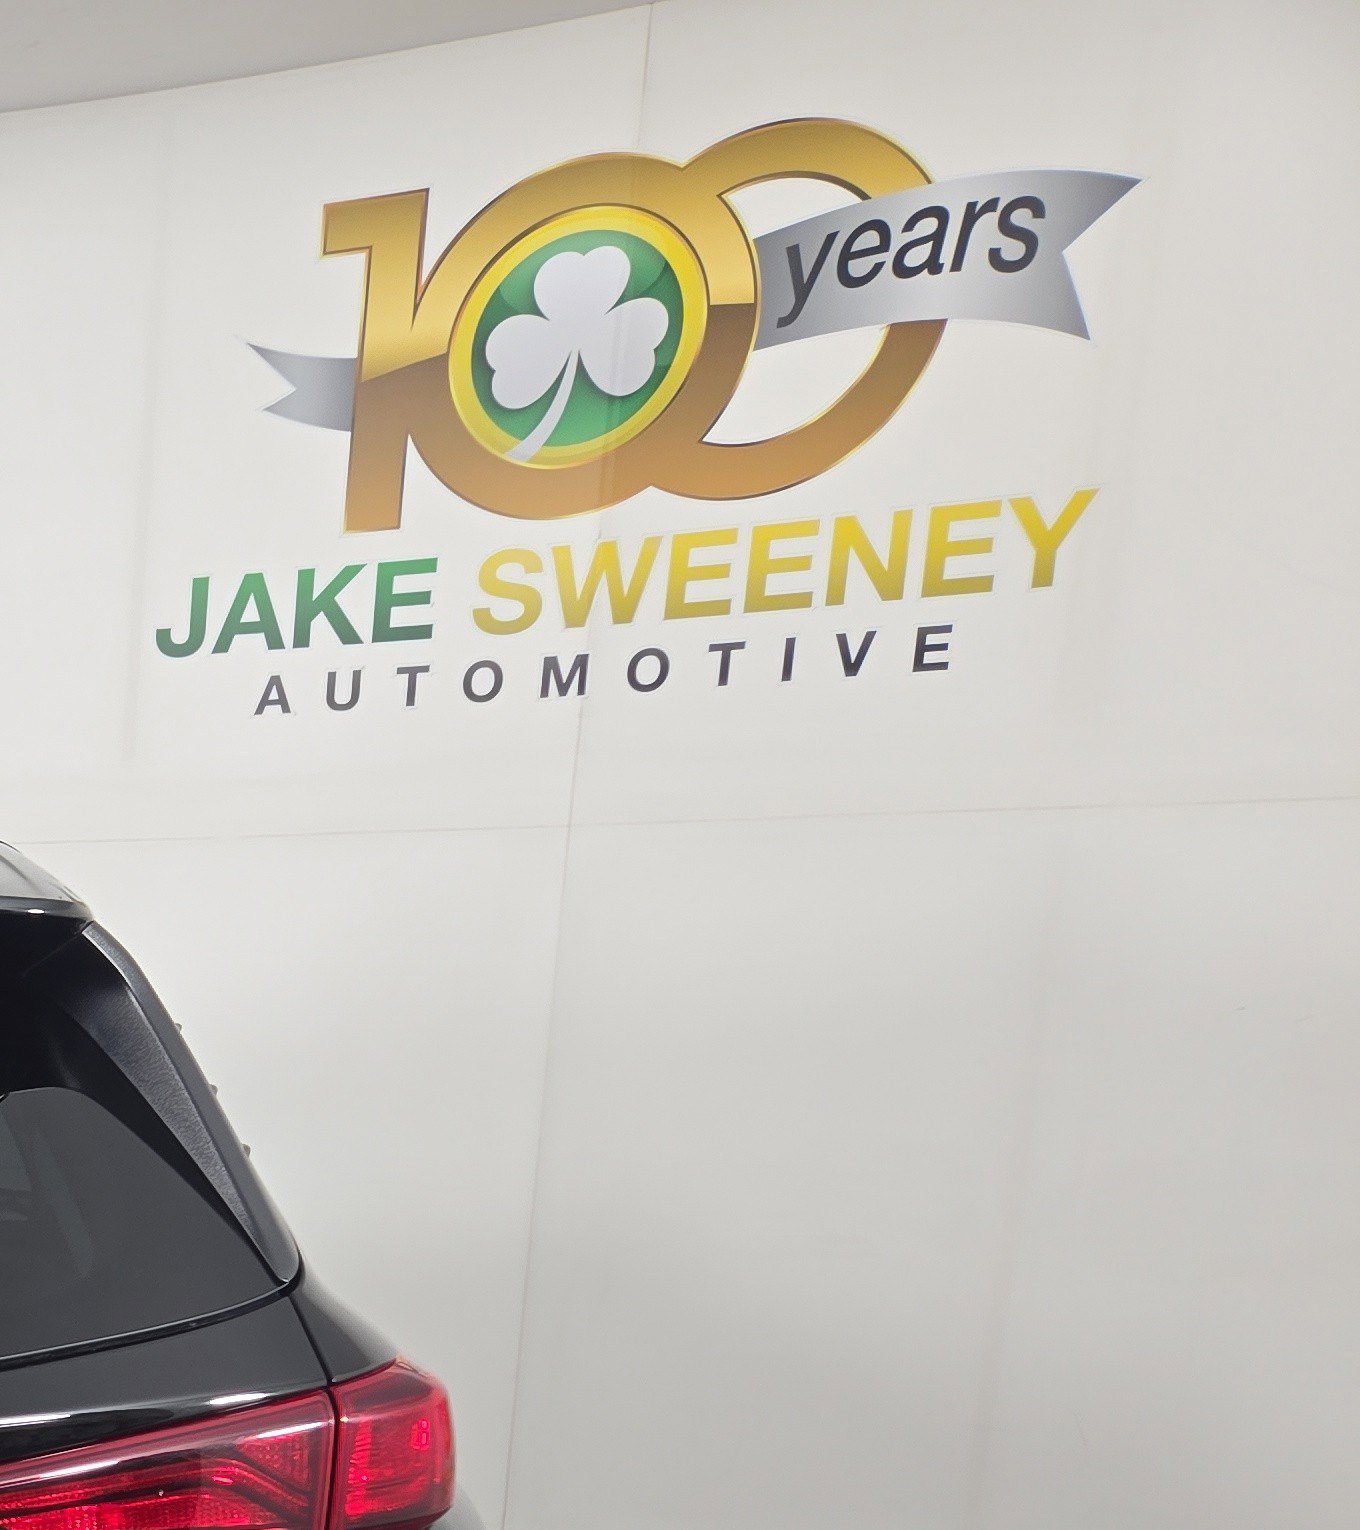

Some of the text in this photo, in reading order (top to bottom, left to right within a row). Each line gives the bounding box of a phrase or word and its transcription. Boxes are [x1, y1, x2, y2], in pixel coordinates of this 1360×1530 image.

[322, 117, 948, 532] 100
[776, 194, 1045, 329] years
[155, 489, 1100, 659] JAKE SWEENEY
[254, 623, 953, 715] AUTOMOTIVE
